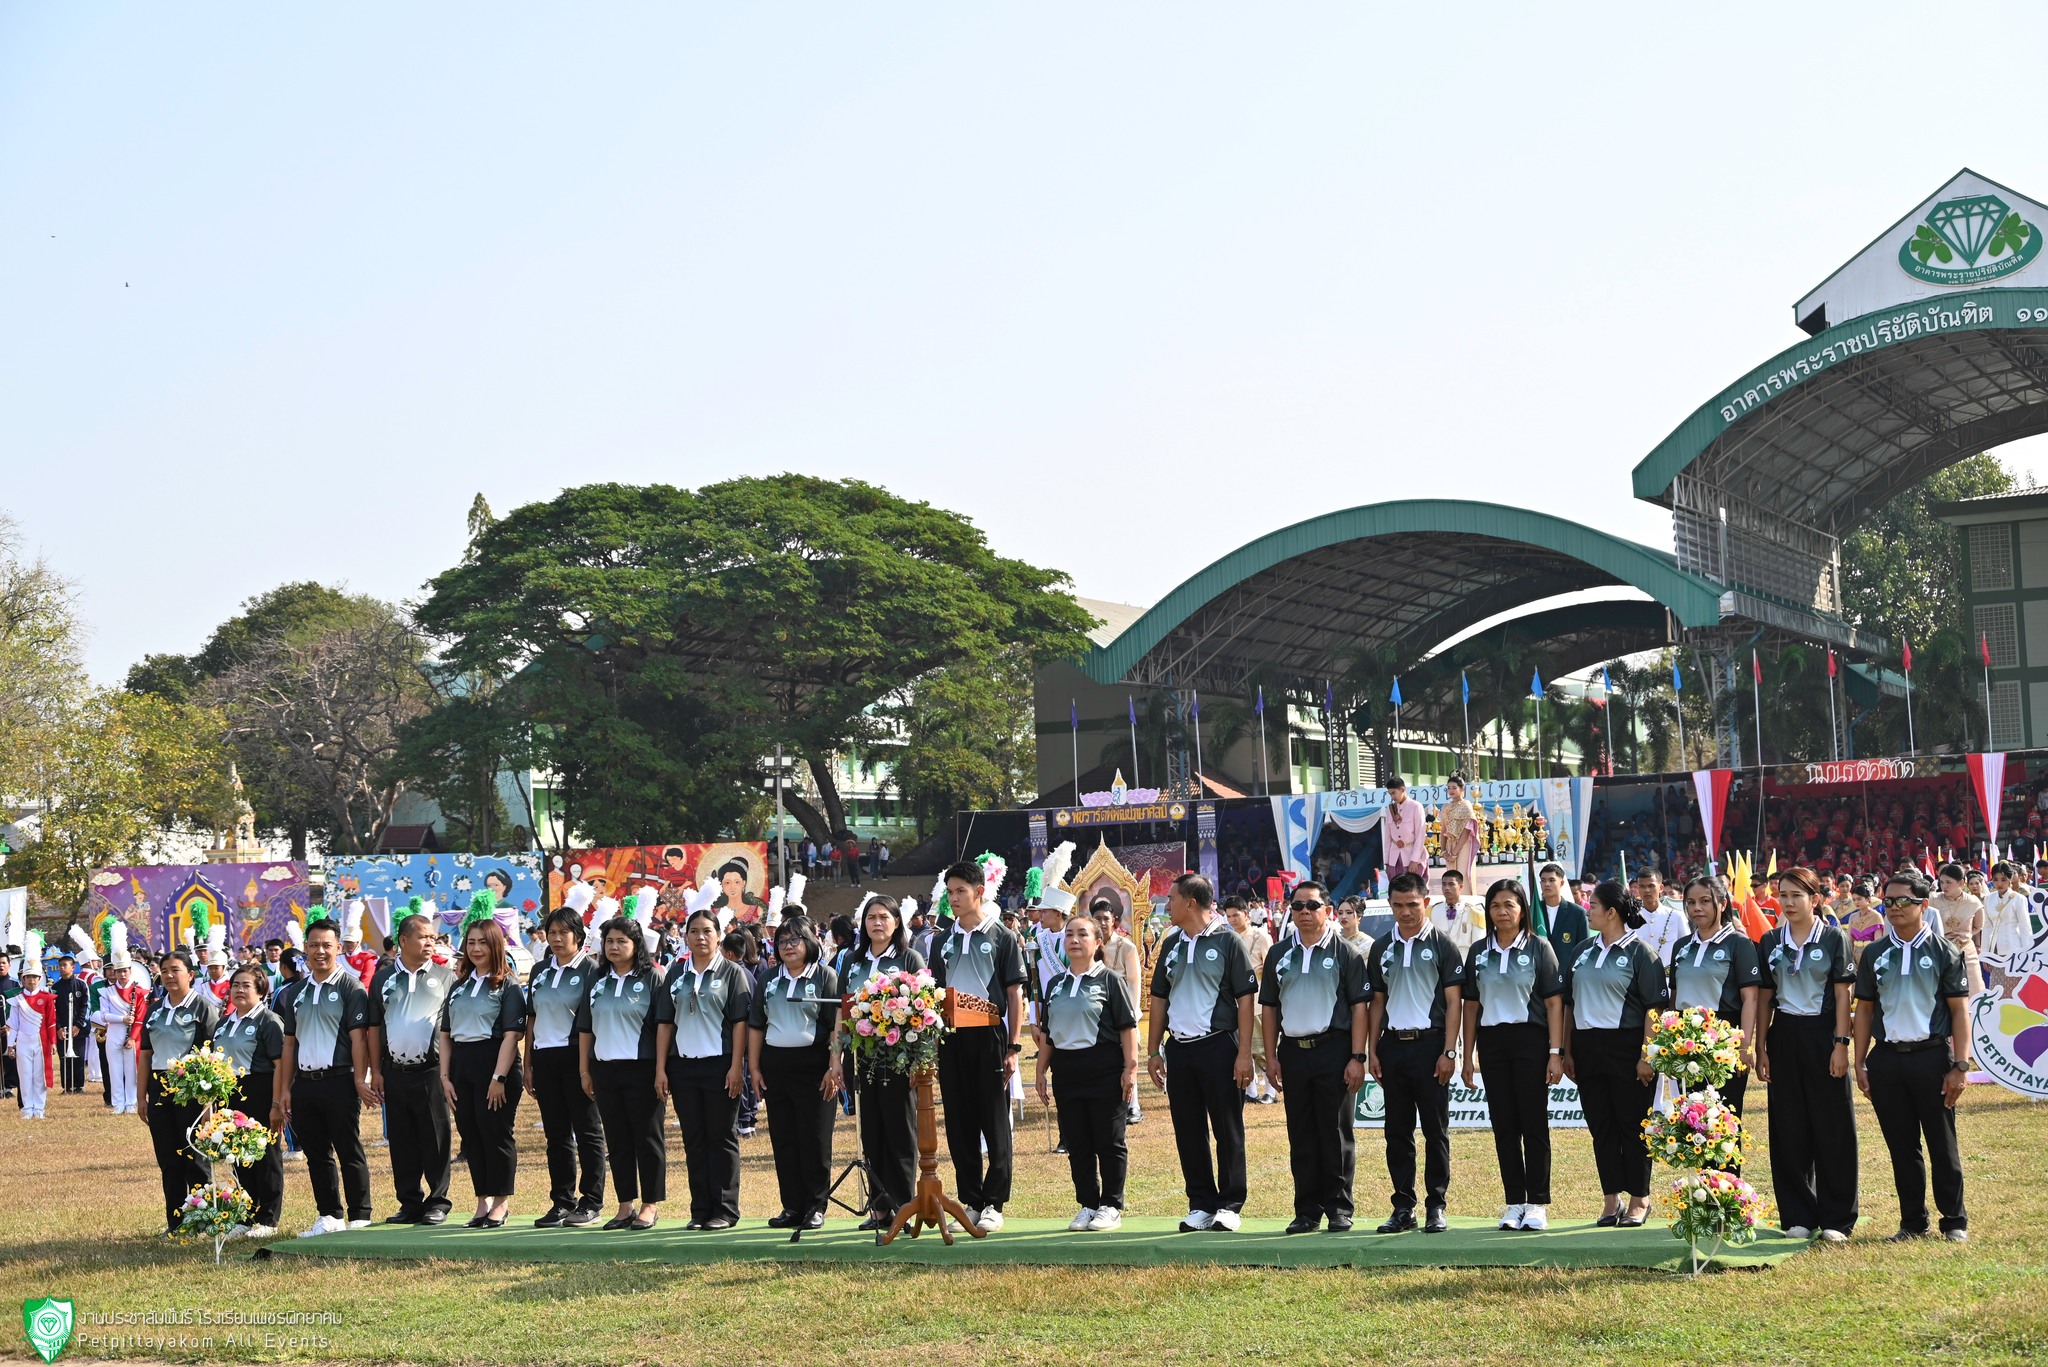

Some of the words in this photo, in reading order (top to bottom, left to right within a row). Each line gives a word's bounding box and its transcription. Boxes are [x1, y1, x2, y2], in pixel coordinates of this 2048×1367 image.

[1720, 301, 1993, 422] อาคารพระราชปริยัติบัณฑิต
[1547, 1110, 1584, 1121] SCHO
